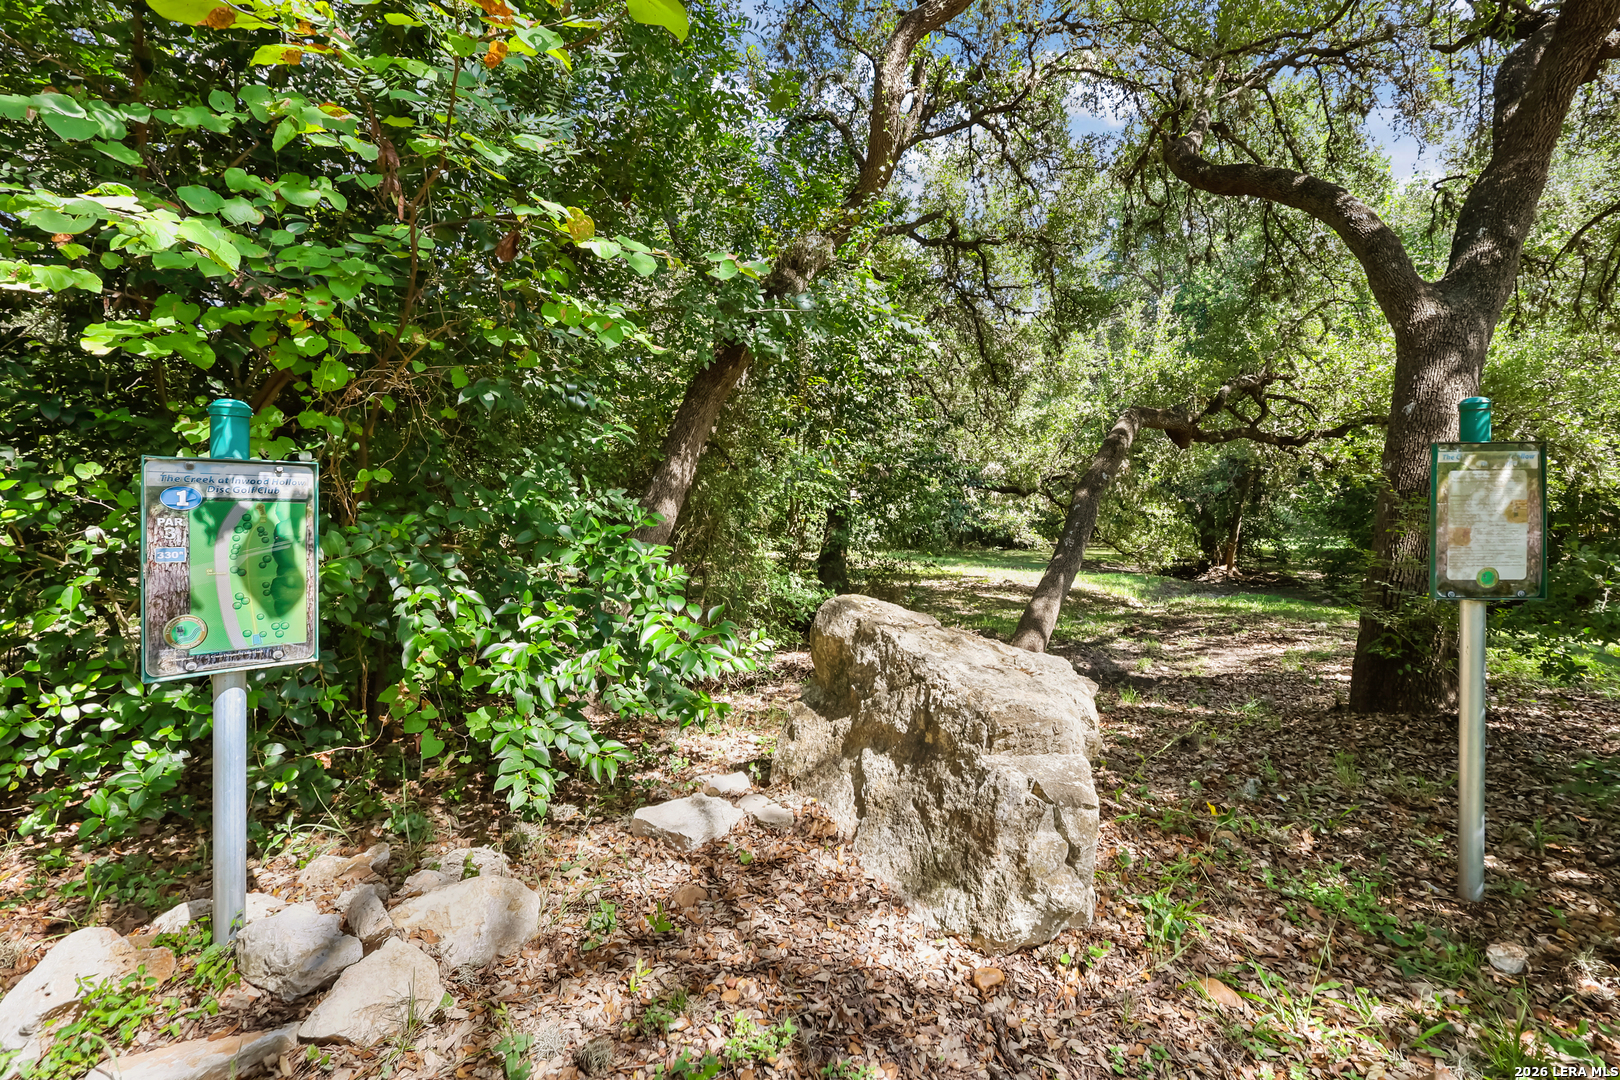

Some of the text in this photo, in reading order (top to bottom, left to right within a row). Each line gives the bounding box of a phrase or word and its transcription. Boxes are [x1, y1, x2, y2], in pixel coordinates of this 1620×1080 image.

[160, 474, 306, 487] The Creek at Inwood Hollow
[207, 485, 280, 495] Disc Golf Club
[176, 490, 189, 507] 1
[157, 518, 183, 526] PAR
[163, 527, 176, 539] 3
